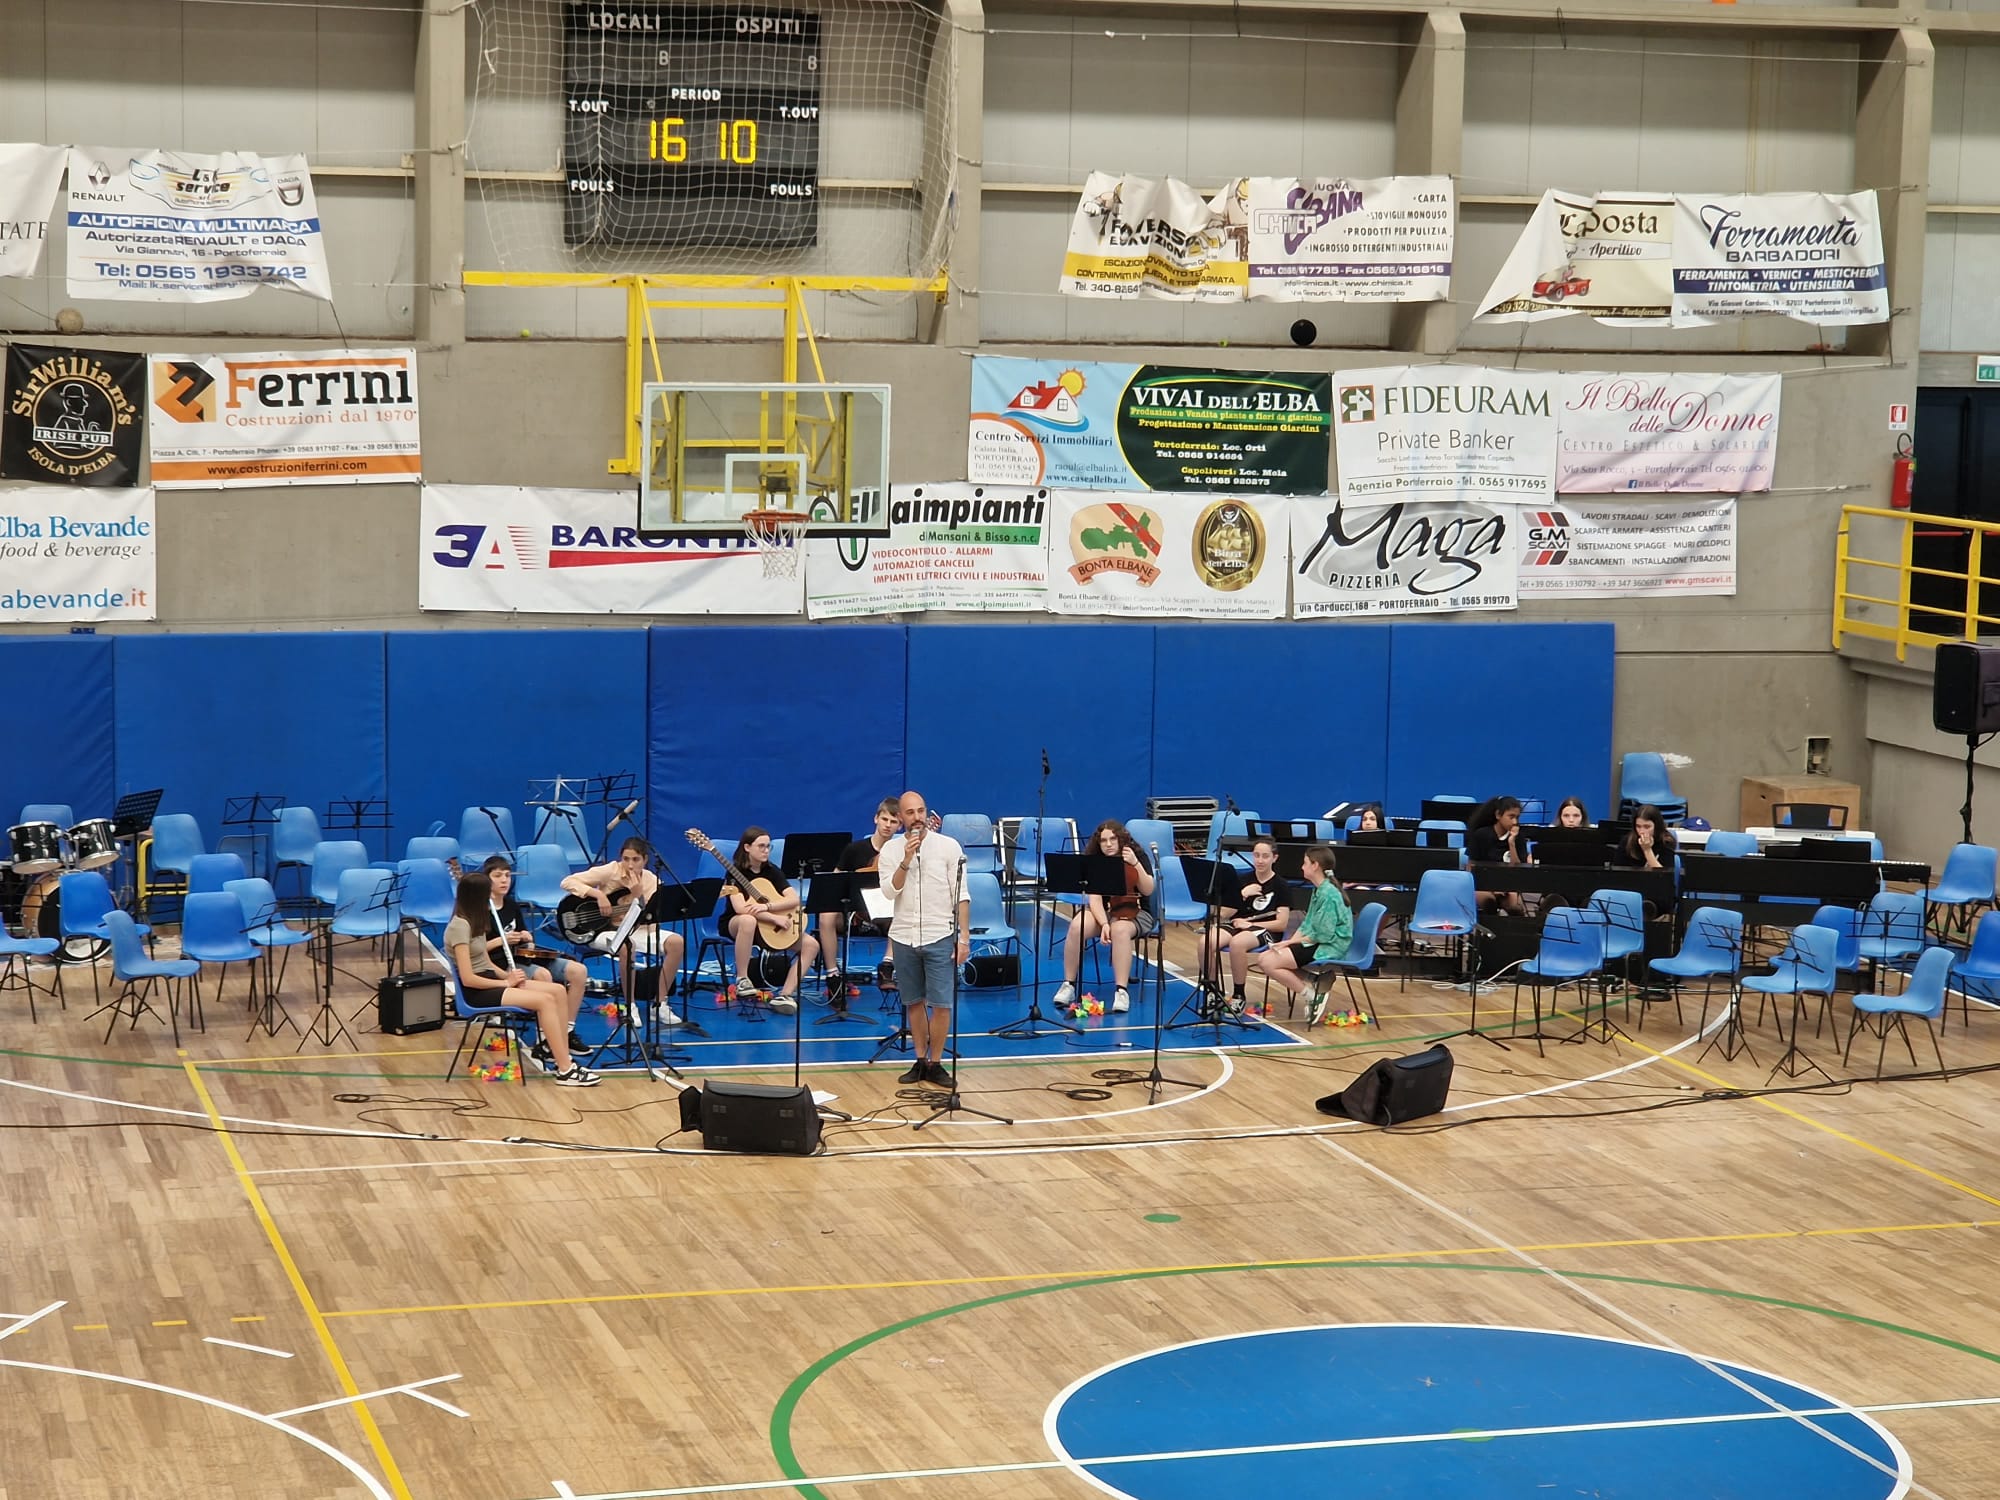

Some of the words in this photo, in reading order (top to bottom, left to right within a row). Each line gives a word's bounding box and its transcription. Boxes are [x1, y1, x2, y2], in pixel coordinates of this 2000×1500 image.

[590, 12, 660, 30] LOCALI
[736, 18, 800, 34] OSPITI
[672, 88, 721, 101] PERIOD
[569, 100, 609, 112] T.OUT
[780, 106, 818, 119] T.OUT
[650, 118, 686, 162] 16
[720, 120, 757, 164] 10
[571, 180, 614, 193] FOULS
[770, 184, 813, 196] FOULS
[72, 192, 126, 202] RENAULT
[1417, 194, 1446, 203] CARTA
[1407, 210, 1447, 219] MONOUSO
[78, 214, 195, 232] AUTOFFICINA
[1700, 204, 1864, 249] Ferramenta
[86, 230, 174, 244] Autorizzata
[174, 236, 245, 246] RENAULT
[1348, 228, 1392, 236] PRODOTTI
[1394, 228, 1407, 236] PER
[1410, 227, 1446, 236] PULIZIA
[115, 246, 134, 254] Via
[1310, 244, 1350, 252] INGROSSO
[1352, 244, 1397, 252] DETERGENTI
[1398, 244, 1448, 252] INDUSTRIALI
[1589, 242, 1642, 258] Aperitivo
[1726, 248, 1840, 262] BARBADORI
[96, 262, 130, 276] Tel:
[136, 264, 196, 279] 0565
[203, 265, 308, 280] 1933742
[1257, 266, 1276, 275] Tel.
[1344, 266, 1364, 275] Fax
[1679, 270, 1750, 281] FERRAMENTA
[1762, 270, 1802, 280] VERNICI
[1708, 281, 1780, 291] TINTOMETRIA
[1790, 280, 1855, 290] UTENSILERIA
[225, 358, 413, 409] Ferrini
[1132, 387, 1204, 408] VIVAI
[1208, 392, 1320, 412] DELL'ELBA
[1384, 385, 1552, 417] FIDEURAM
[1565, 379, 1602, 410] Il
[1606, 378, 1672, 412] Bello
[226, 410, 333, 427] Costruzioni
[340, 410, 368, 423] dal
[376, 410, 414, 422] 1970
[1130, 407, 1176, 416] Produzione
[1186, 410, 1218, 419] Vendita
[1220, 412, 1246, 421] piante
[1256, 412, 1274, 421] fiori
[1288, 414, 1322, 423] giardino
[1628, 415, 1664, 433] delle
[1664, 392, 1773, 434] Donne
[1138, 419, 1202, 430] Progettazione
[1212, 423, 1278, 432] Manutenzione
[1280, 424, 1320, 432] Giardini
[37, 430, 76, 440] IRISH
[81, 434, 110, 444] PUB
[976, 430, 1010, 442] Centro
[1014, 433, 1050, 444] Servizi
[1052, 434, 1113, 446] Immobiliari
[1378, 430, 1440, 451] Private
[1450, 429, 1515, 450] Banker
[1154, 440, 1220, 450] Portoferraio:
[1245, 444, 1266, 452] Orti
[974, 454, 1038, 462] PORTOFERRAIO
[1156, 450, 1174, 458] Tel.
[28, 447, 65, 474] ISOLA
[68, 452, 116, 476] D'ELBA
[208, 460, 368, 475] www.costruzioniferrini.com
[1181, 466, 1236, 476] Capoliveri:
[1239, 468, 1260, 476] Loc.
[1564, 466, 1579, 474] Via
[1581, 466, 1597, 474] San
[1046, 474, 1127, 484] www.caseallelba.it
[1184, 476, 1202, 484] Tel.
[1348, 480, 1392, 492] Agenzia
[1480, 476, 1504, 486] 0565
[1507, 478, 1546, 489] 917695
[1582, 512, 1610, 520] LAVORI
[1611, 512, 1648, 520] STRADALI
[1655, 512, 1676, 520] SCAVI
[1682, 508, 1731, 520] DEMOLIZIONI
[48, 515, 150, 538] Bevande
[1574, 527, 1610, 535] SCARPATE
[1612, 526, 1644, 534] ARMATE
[1650, 525, 1695, 534] ASSISTENZA
[1698, 524, 1731, 532] CANTIERI
[928, 531, 971, 543] Mansani
[974, 532, 981, 542] &
[986, 530, 1010, 543] Bisso
[1013, 533, 1038, 544] s.n.c.
[1528, 528, 1570, 541] G.M.
[0, 542, 39, 558] food
[44, 542, 59, 557] &
[65, 542, 142, 560] beverage
[1528, 541, 1570, 550] SCAVI
[1576, 542, 1632, 550] SISTEMAZIONE
[1634, 541, 1666, 550] SPIAGGE
[1674, 540, 1695, 549] MURI
[1696, 539, 1731, 548] CICLOPICI
[956, 547, 992, 556] ALLARMI
[934, 560, 975, 568] CANCELLI
[1568, 558, 1626, 566] SBANCAMENTI
[1632, 556, 1687, 566] INSTALLAZIONE
[1690, 554, 1731, 563] TUBAZIONI
[1078, 560, 1114, 576] BONTA
[1116, 560, 1154, 578] ELBANE
[873, 572, 914, 584] IMPIANTI
[954, 572, 980, 581] CIVILI
[982, 572, 988, 580] E
[990, 572, 1044, 582] INDUSTRIALI
[1329, 573, 1400, 588] PIZZERIA
[1530, 580, 1544, 588] +39
[1546, 580, 1563, 588] 0565
[1566, 580, 1596, 588] 1930792
[1602, 580, 1615, 588] +39
[1618, 580, 1630, 588] 347
[1664, 575, 1732, 586] www.gmscavi.it
[1, 588, 147, 608] abevande.it
[1300, 602, 1312, 613] Via
[1379, 598, 1440, 610] PORTOFERRAIO
[1462, 597, 1481, 606] 0565
[1484, 596, 1510, 605] 919170
